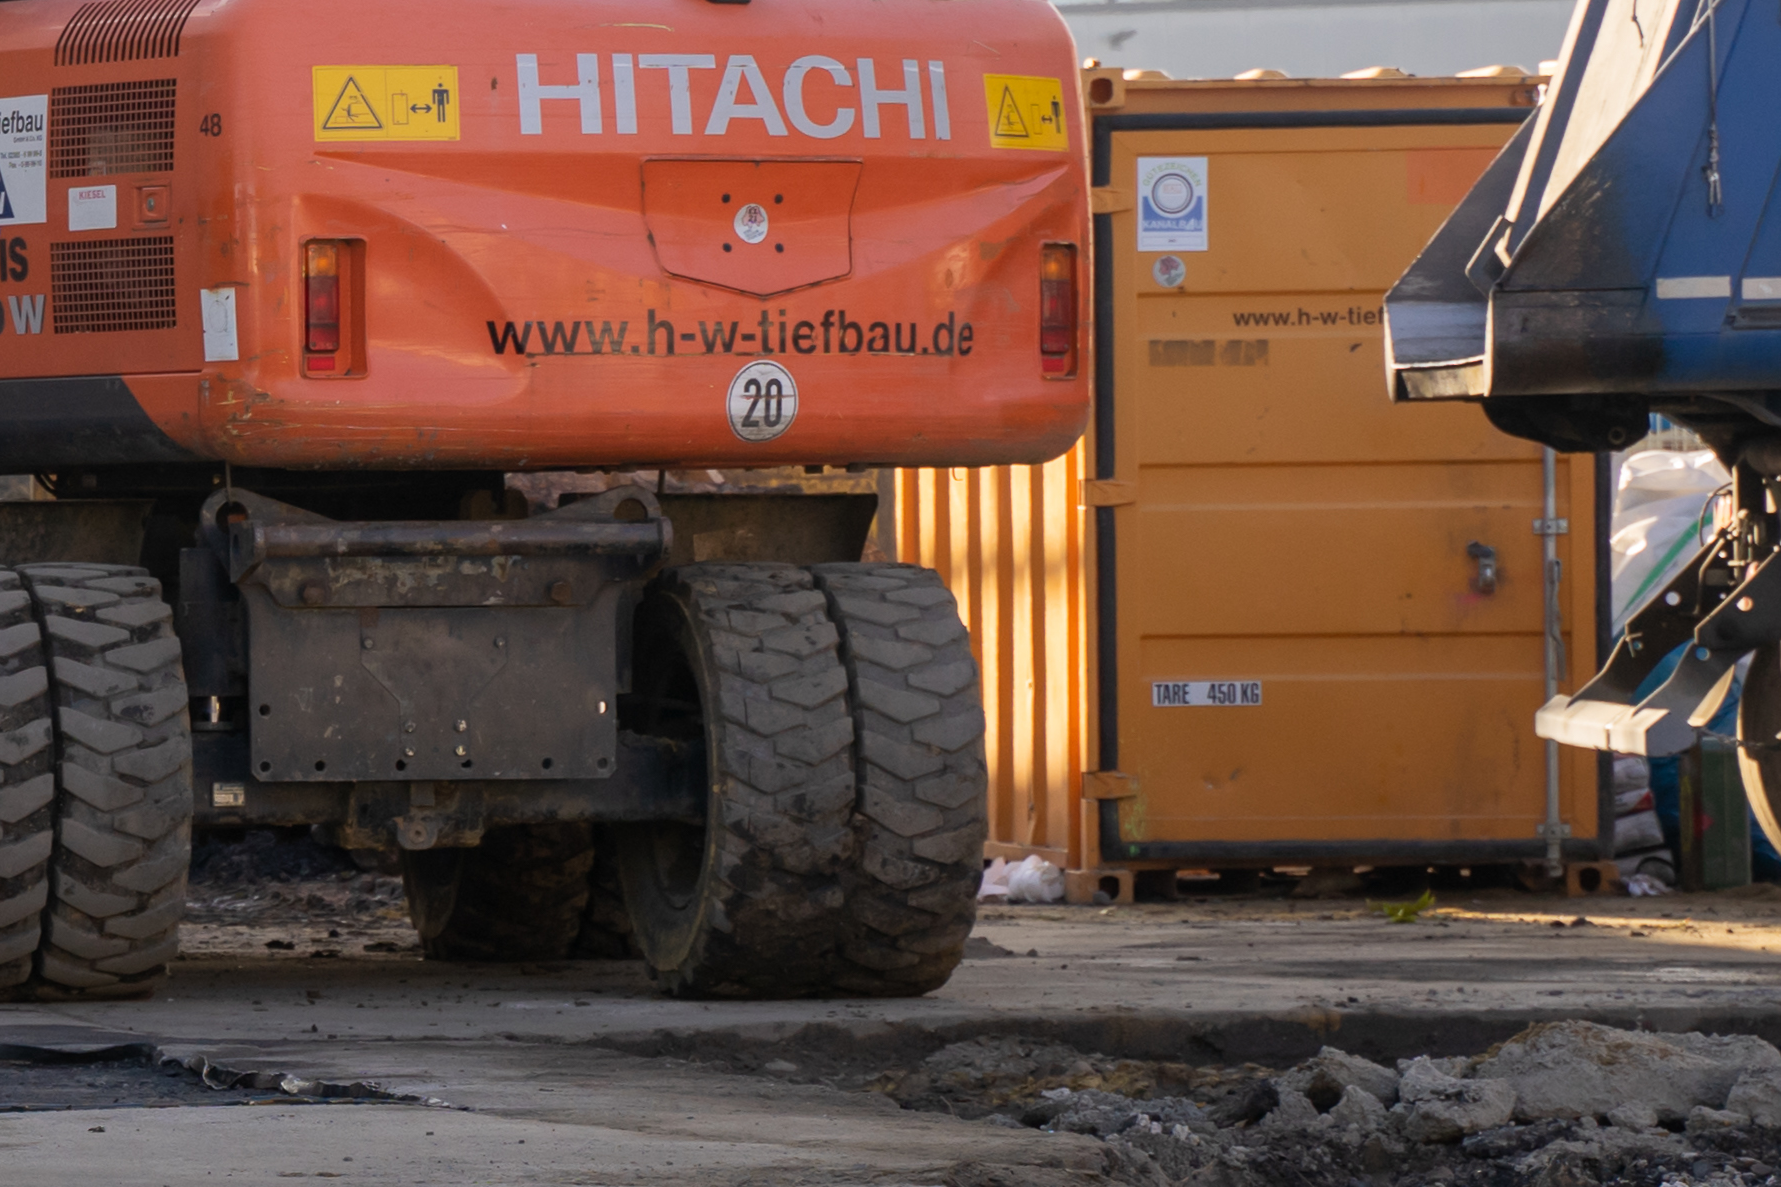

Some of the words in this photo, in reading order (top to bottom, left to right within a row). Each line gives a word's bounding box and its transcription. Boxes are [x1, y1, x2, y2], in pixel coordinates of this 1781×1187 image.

[515, 53, 952, 140] HITACHI
[200, 114, 222, 137] 48
[487, 309, 975, 357] www.h-w-tiefbau.de
[742, 379, 783, 428] 20
[1154, 684, 1190, 704] TARE
[1207, 683, 1236, 704] 450
[1240, 682, 1259, 704] KG
